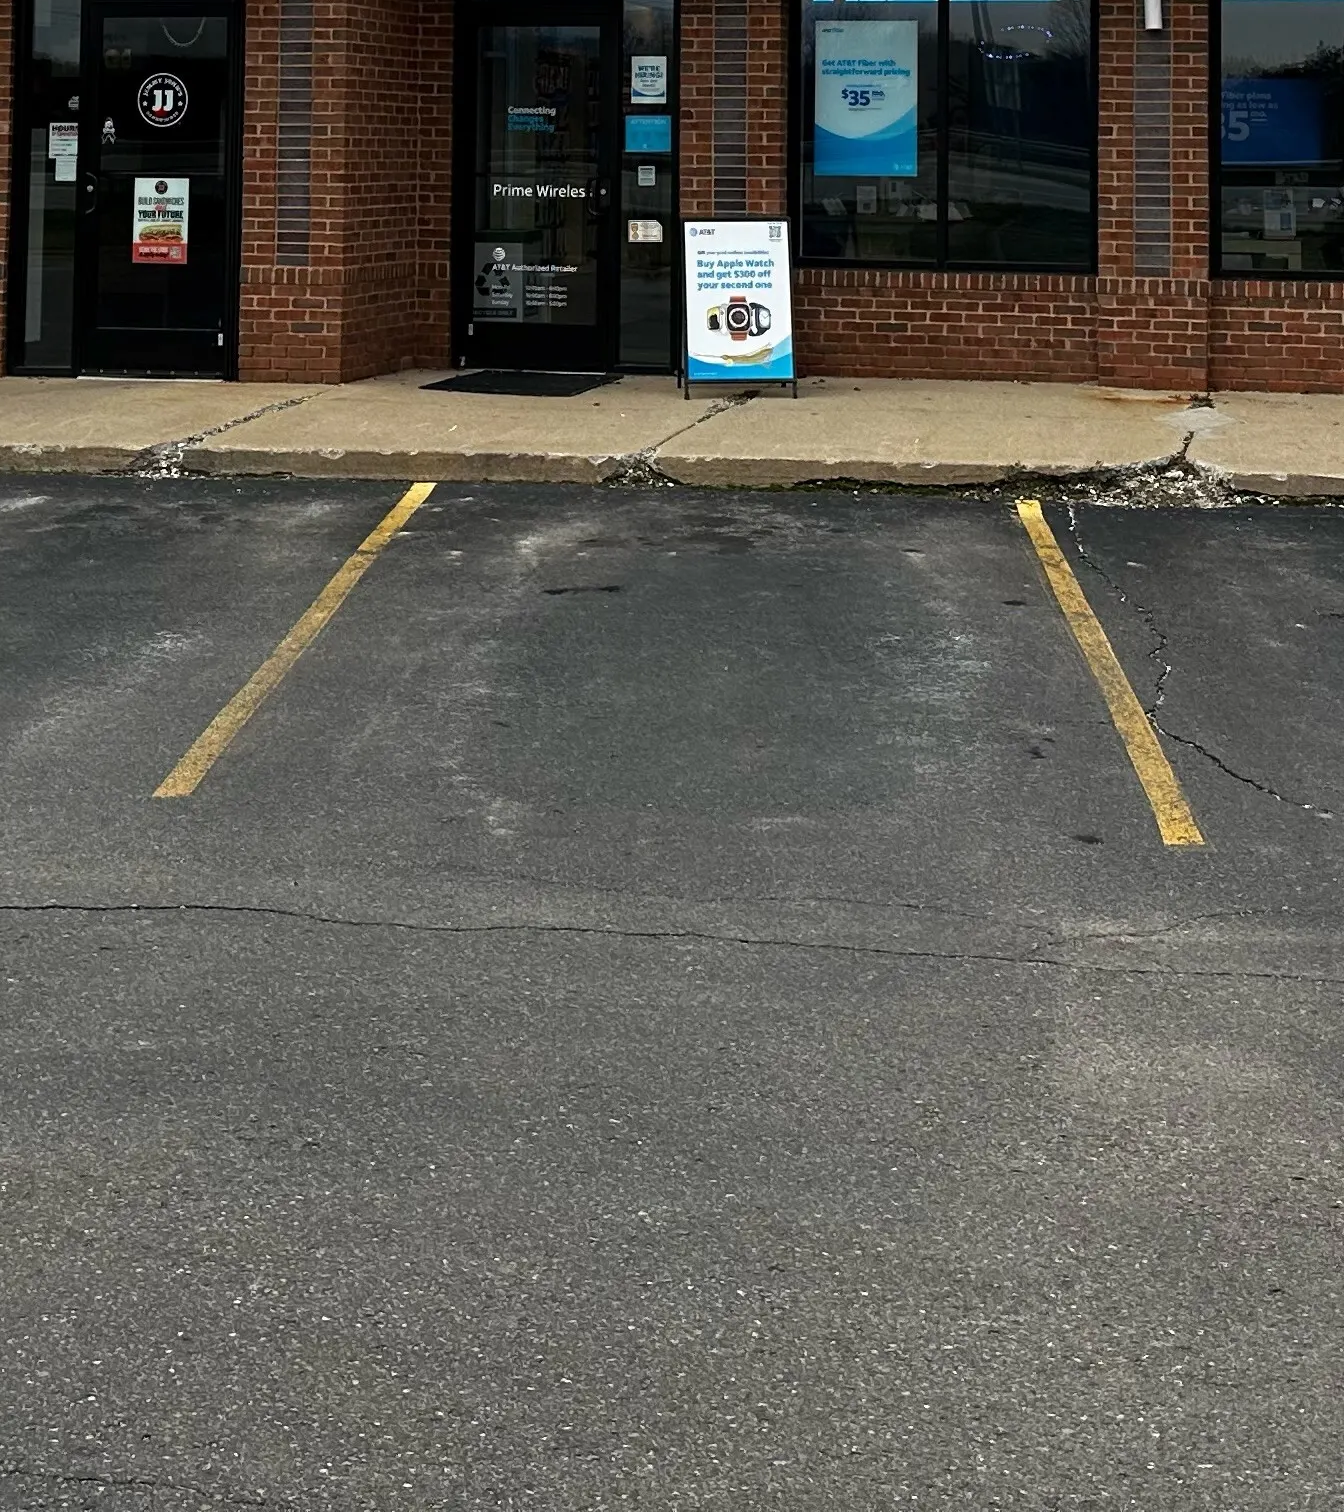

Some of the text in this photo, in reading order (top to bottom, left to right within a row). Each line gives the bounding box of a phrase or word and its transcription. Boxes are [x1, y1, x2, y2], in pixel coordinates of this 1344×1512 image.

[822, 59, 836, 67] Get
[837, 59, 857, 67] AT&T
[878, 59, 897, 67] with
[152, 90, 174, 111] JJ
[841, 88, 871, 106] $35
[508, 106, 556, 116] Connecting
[493, 184, 533, 197] Prime
[697, 259, 775, 269] Buy Apple Watch
[697, 270, 715, 279] and
[716, 270, 732, 281] get
[757, 270, 771, 278] off
[697, 280, 773, 291] your second one
